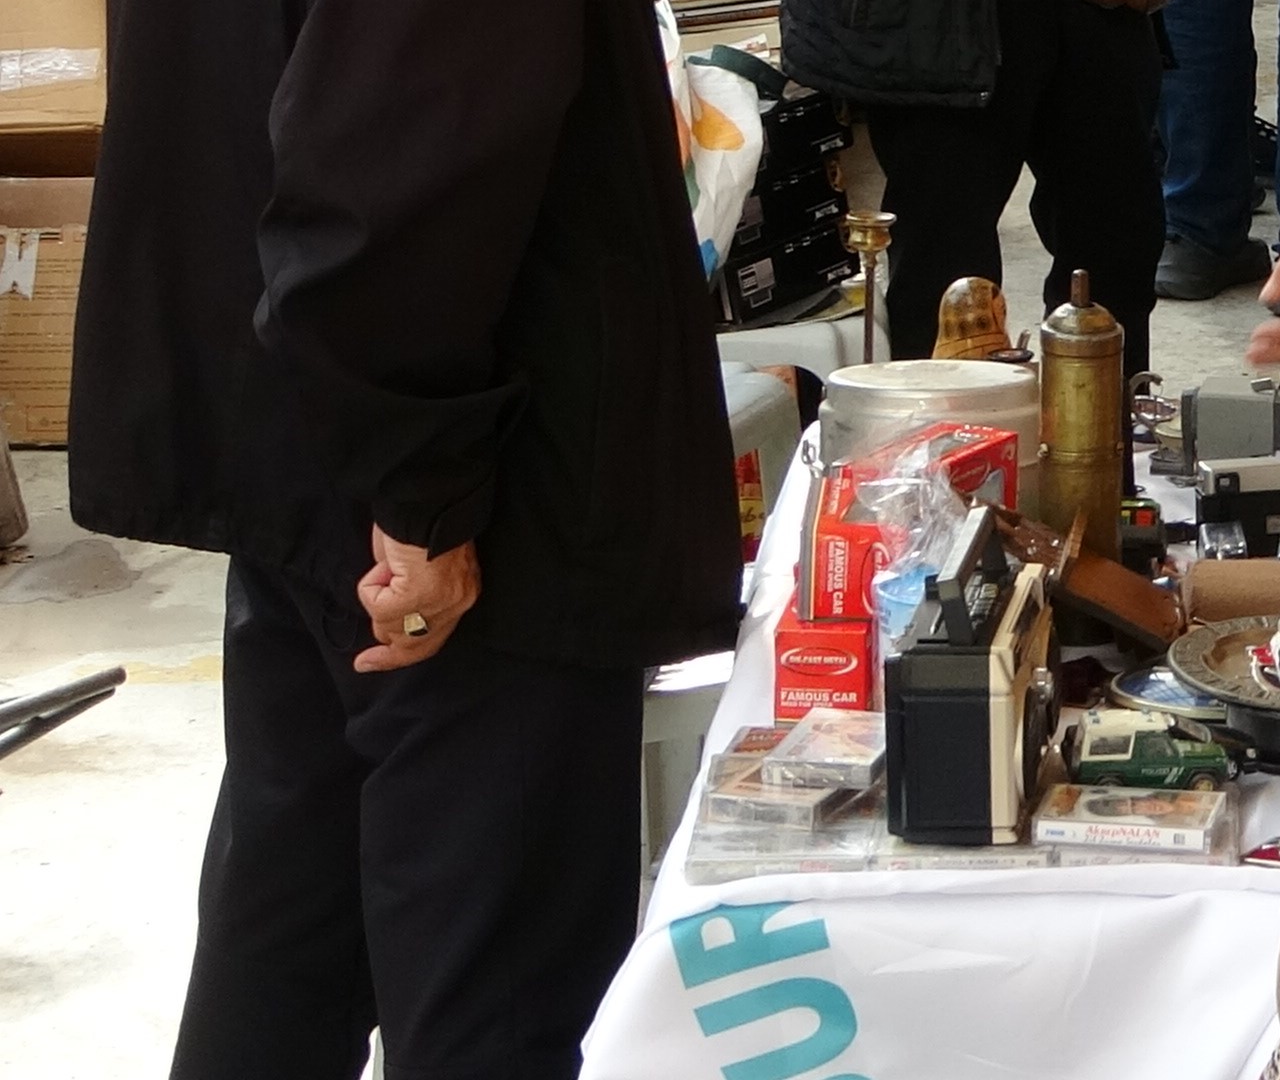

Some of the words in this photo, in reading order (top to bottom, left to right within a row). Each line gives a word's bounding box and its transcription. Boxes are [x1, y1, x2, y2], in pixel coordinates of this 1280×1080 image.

[833, 541, 846, 589] FAMOUS
[832, 591, 845, 616] CAR
[780, 691, 830, 702] FAMOUS
[832, 692, 858, 703] CAR
[668, 900, 872, 1080] UR
